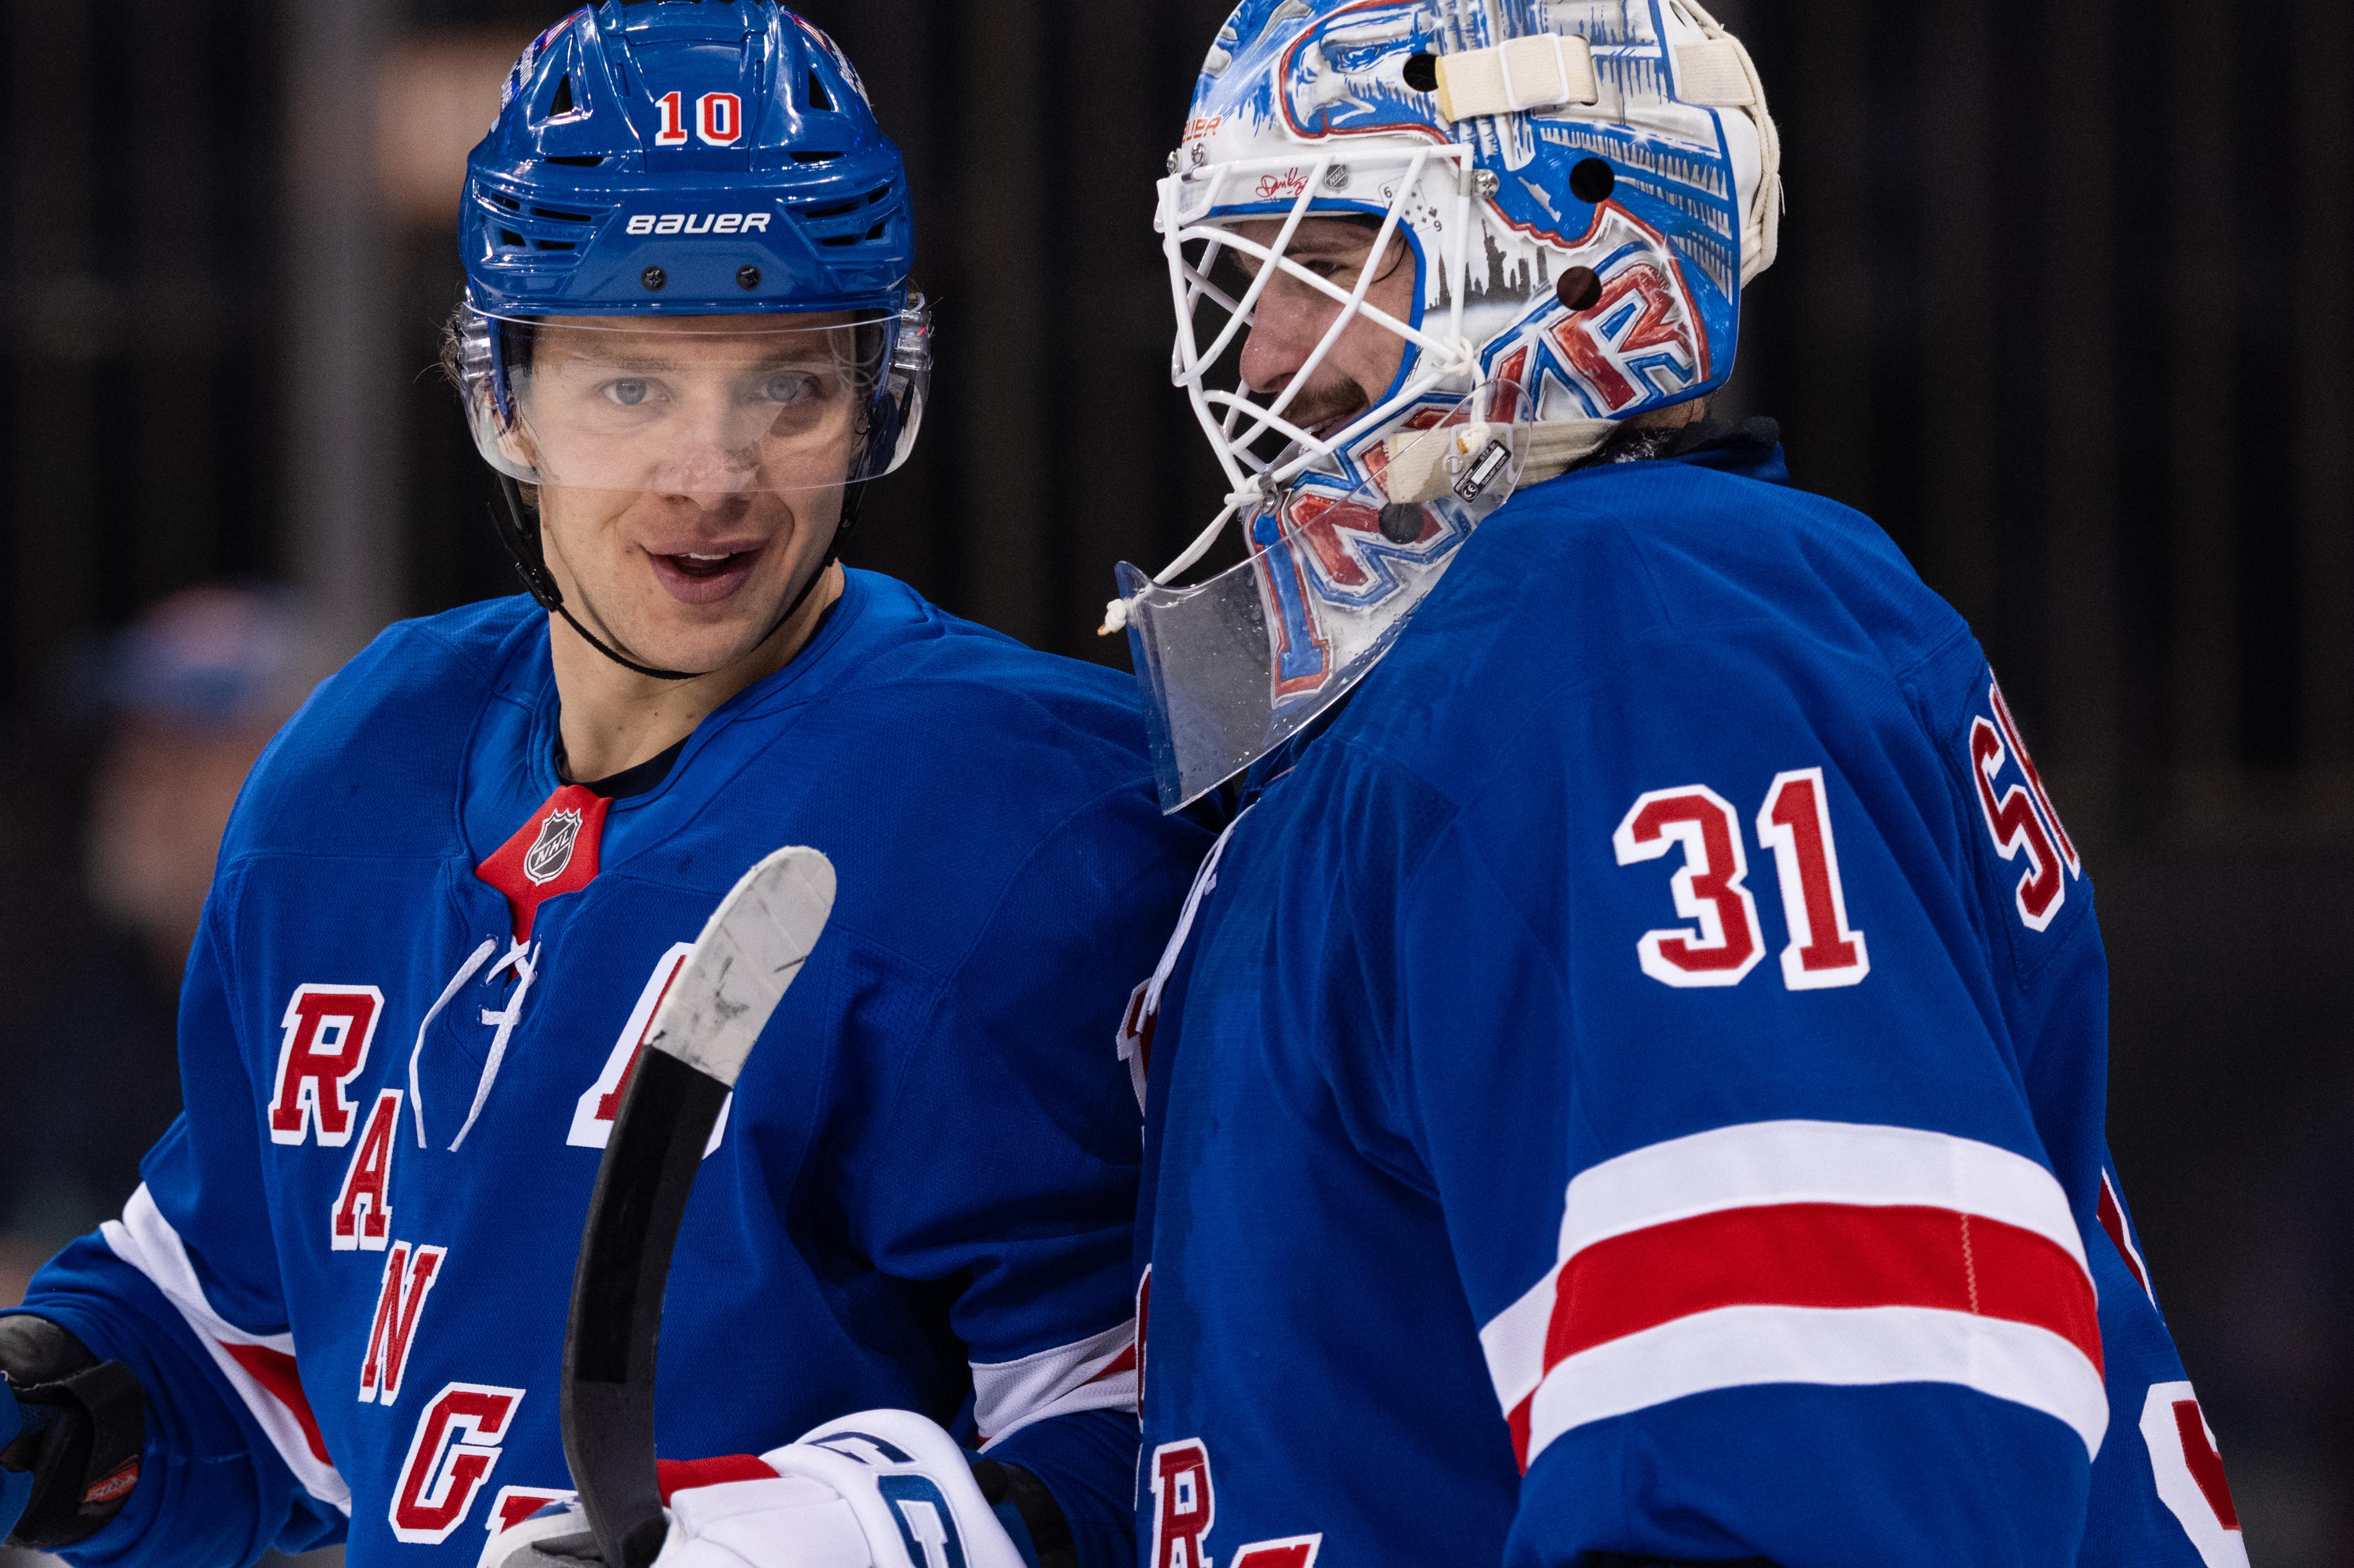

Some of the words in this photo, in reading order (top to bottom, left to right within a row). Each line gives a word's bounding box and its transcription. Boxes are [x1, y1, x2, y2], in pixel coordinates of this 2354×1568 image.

[655, 91, 742, 147] 10
[626, 213, 771, 234] BAUER
[1481, 455, 1508, 485] bauer.com
[1612, 766, 1870, 990] 31
